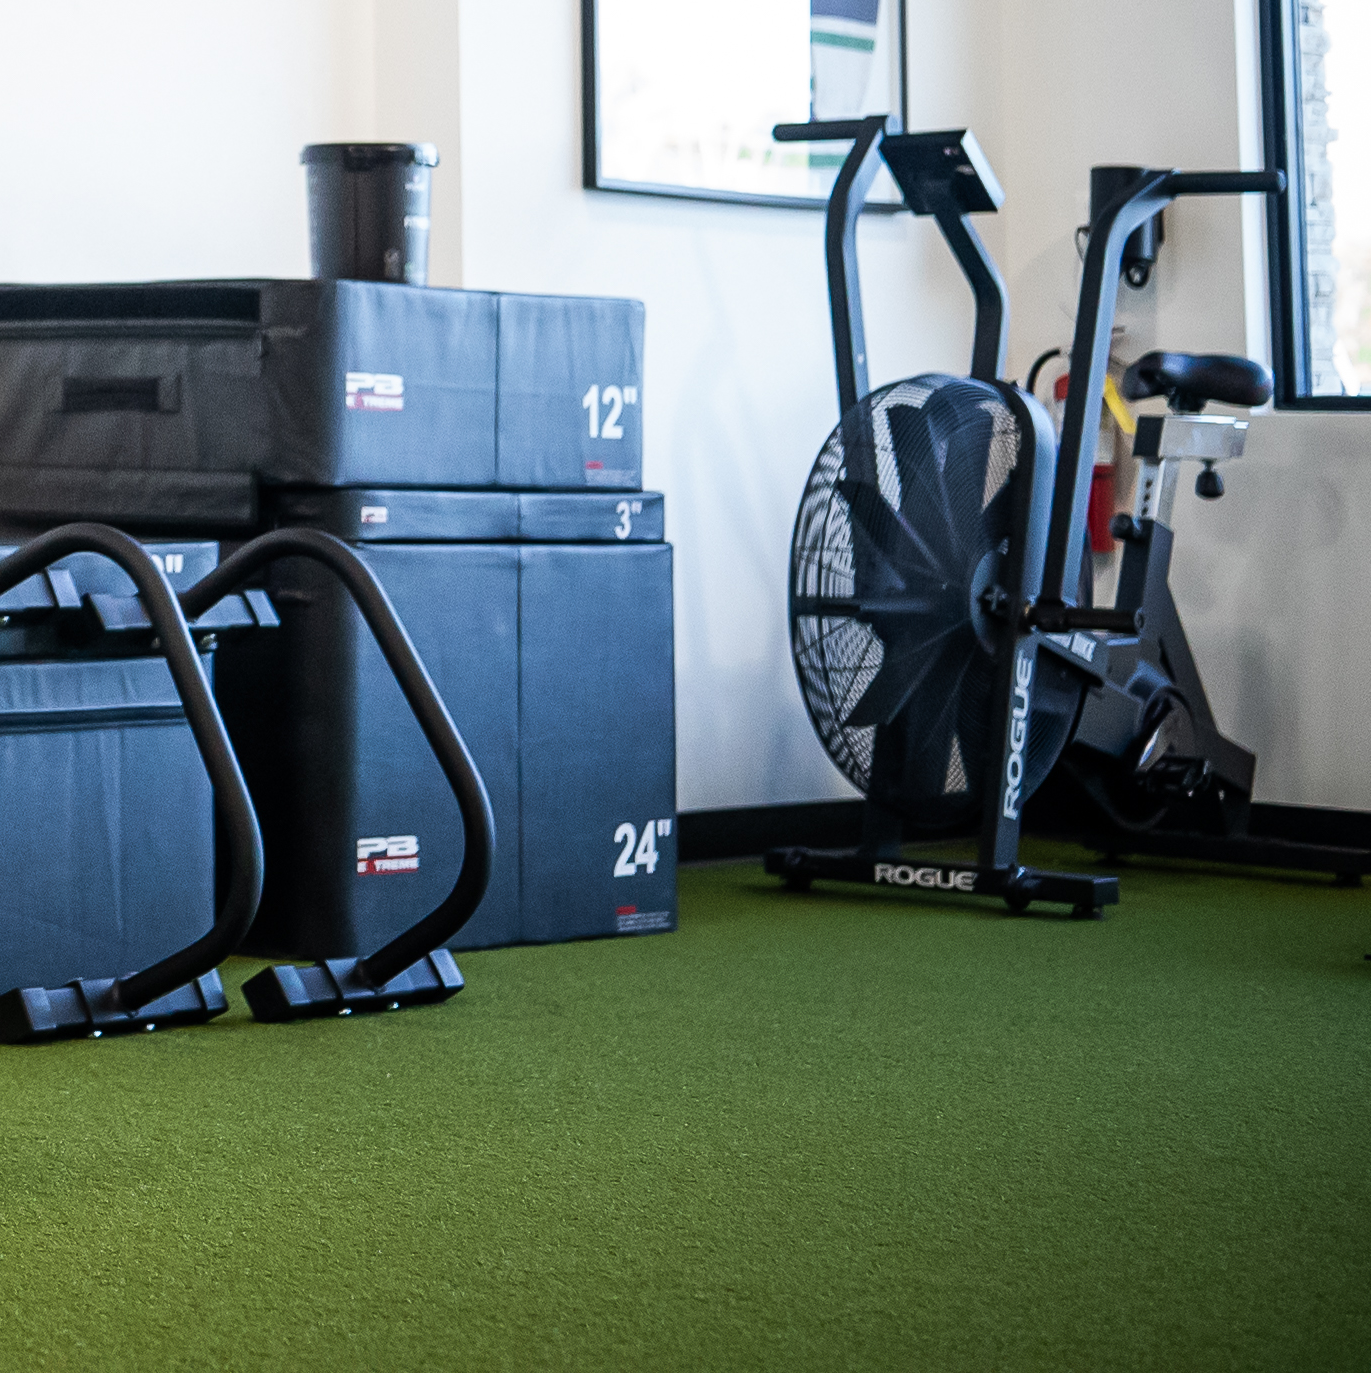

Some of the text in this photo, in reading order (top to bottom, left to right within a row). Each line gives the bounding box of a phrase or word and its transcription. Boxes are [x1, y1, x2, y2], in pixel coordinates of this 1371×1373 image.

[345, 371, 404, 396] PB
[582, 384, 638, 439] 12"
[614, 500, 643, 540] 3"
[1003, 649, 1033, 820] ROGUE
[357, 834, 419, 859] PB
[613, 818, 672, 878] 24"
[874, 862, 978, 892] ROGUE
